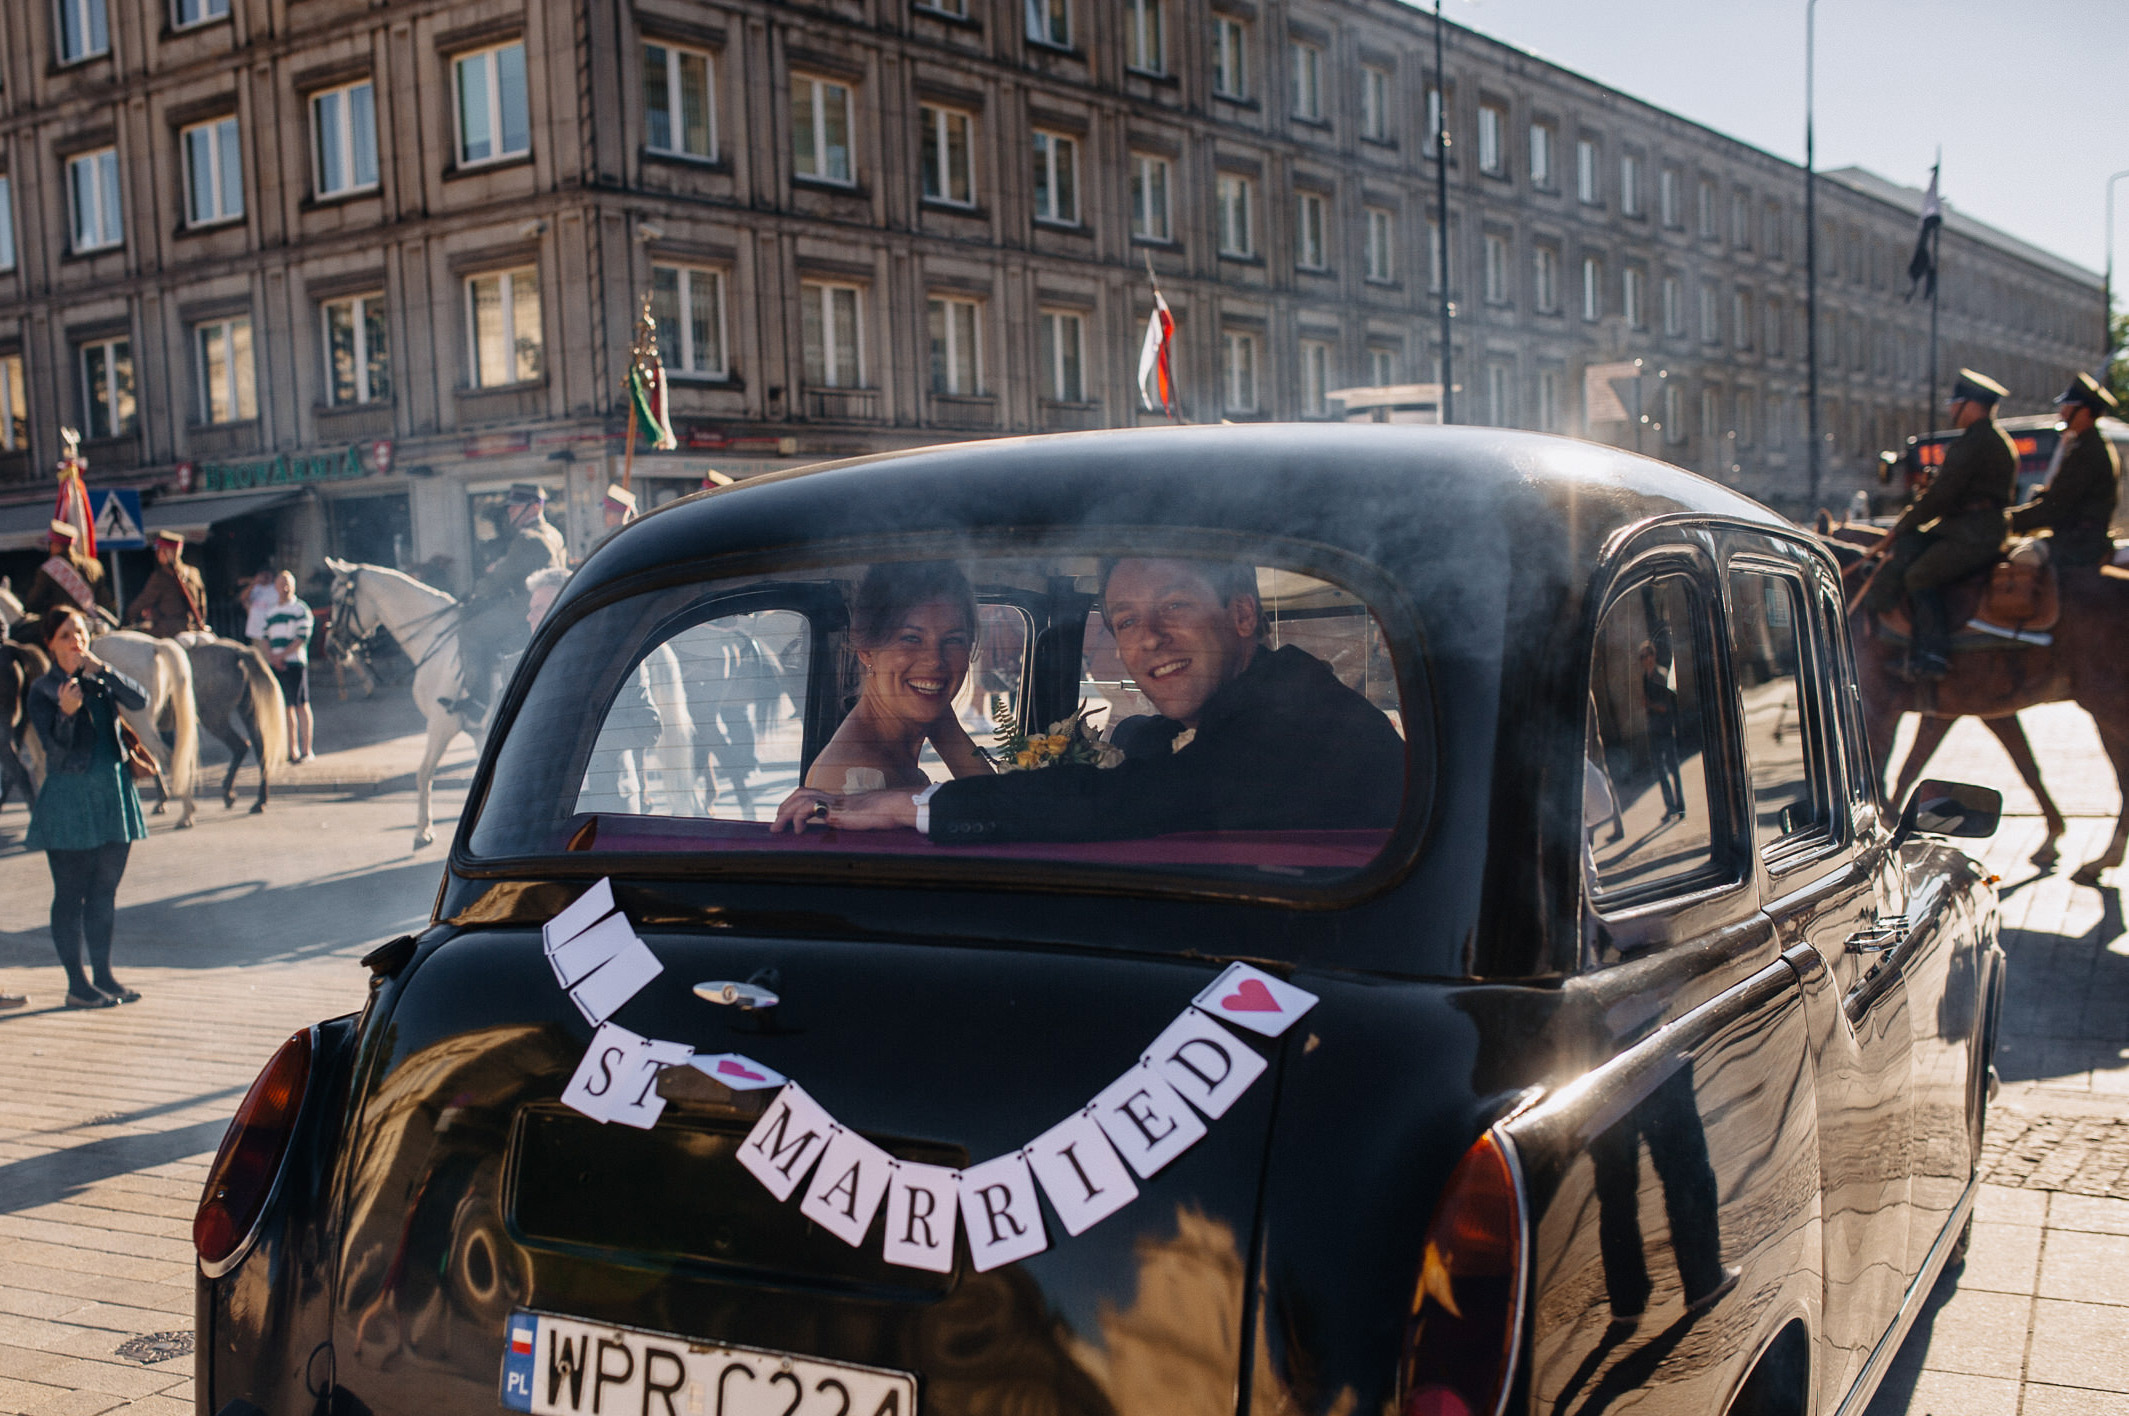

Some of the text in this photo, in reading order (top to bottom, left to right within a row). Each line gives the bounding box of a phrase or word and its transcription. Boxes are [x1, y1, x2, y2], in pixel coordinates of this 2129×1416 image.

[753, 1036, 1232, 1249] MARRIED
[507, 1371, 529, 1396] PL
[547, 1329, 686, 1416] WPR
